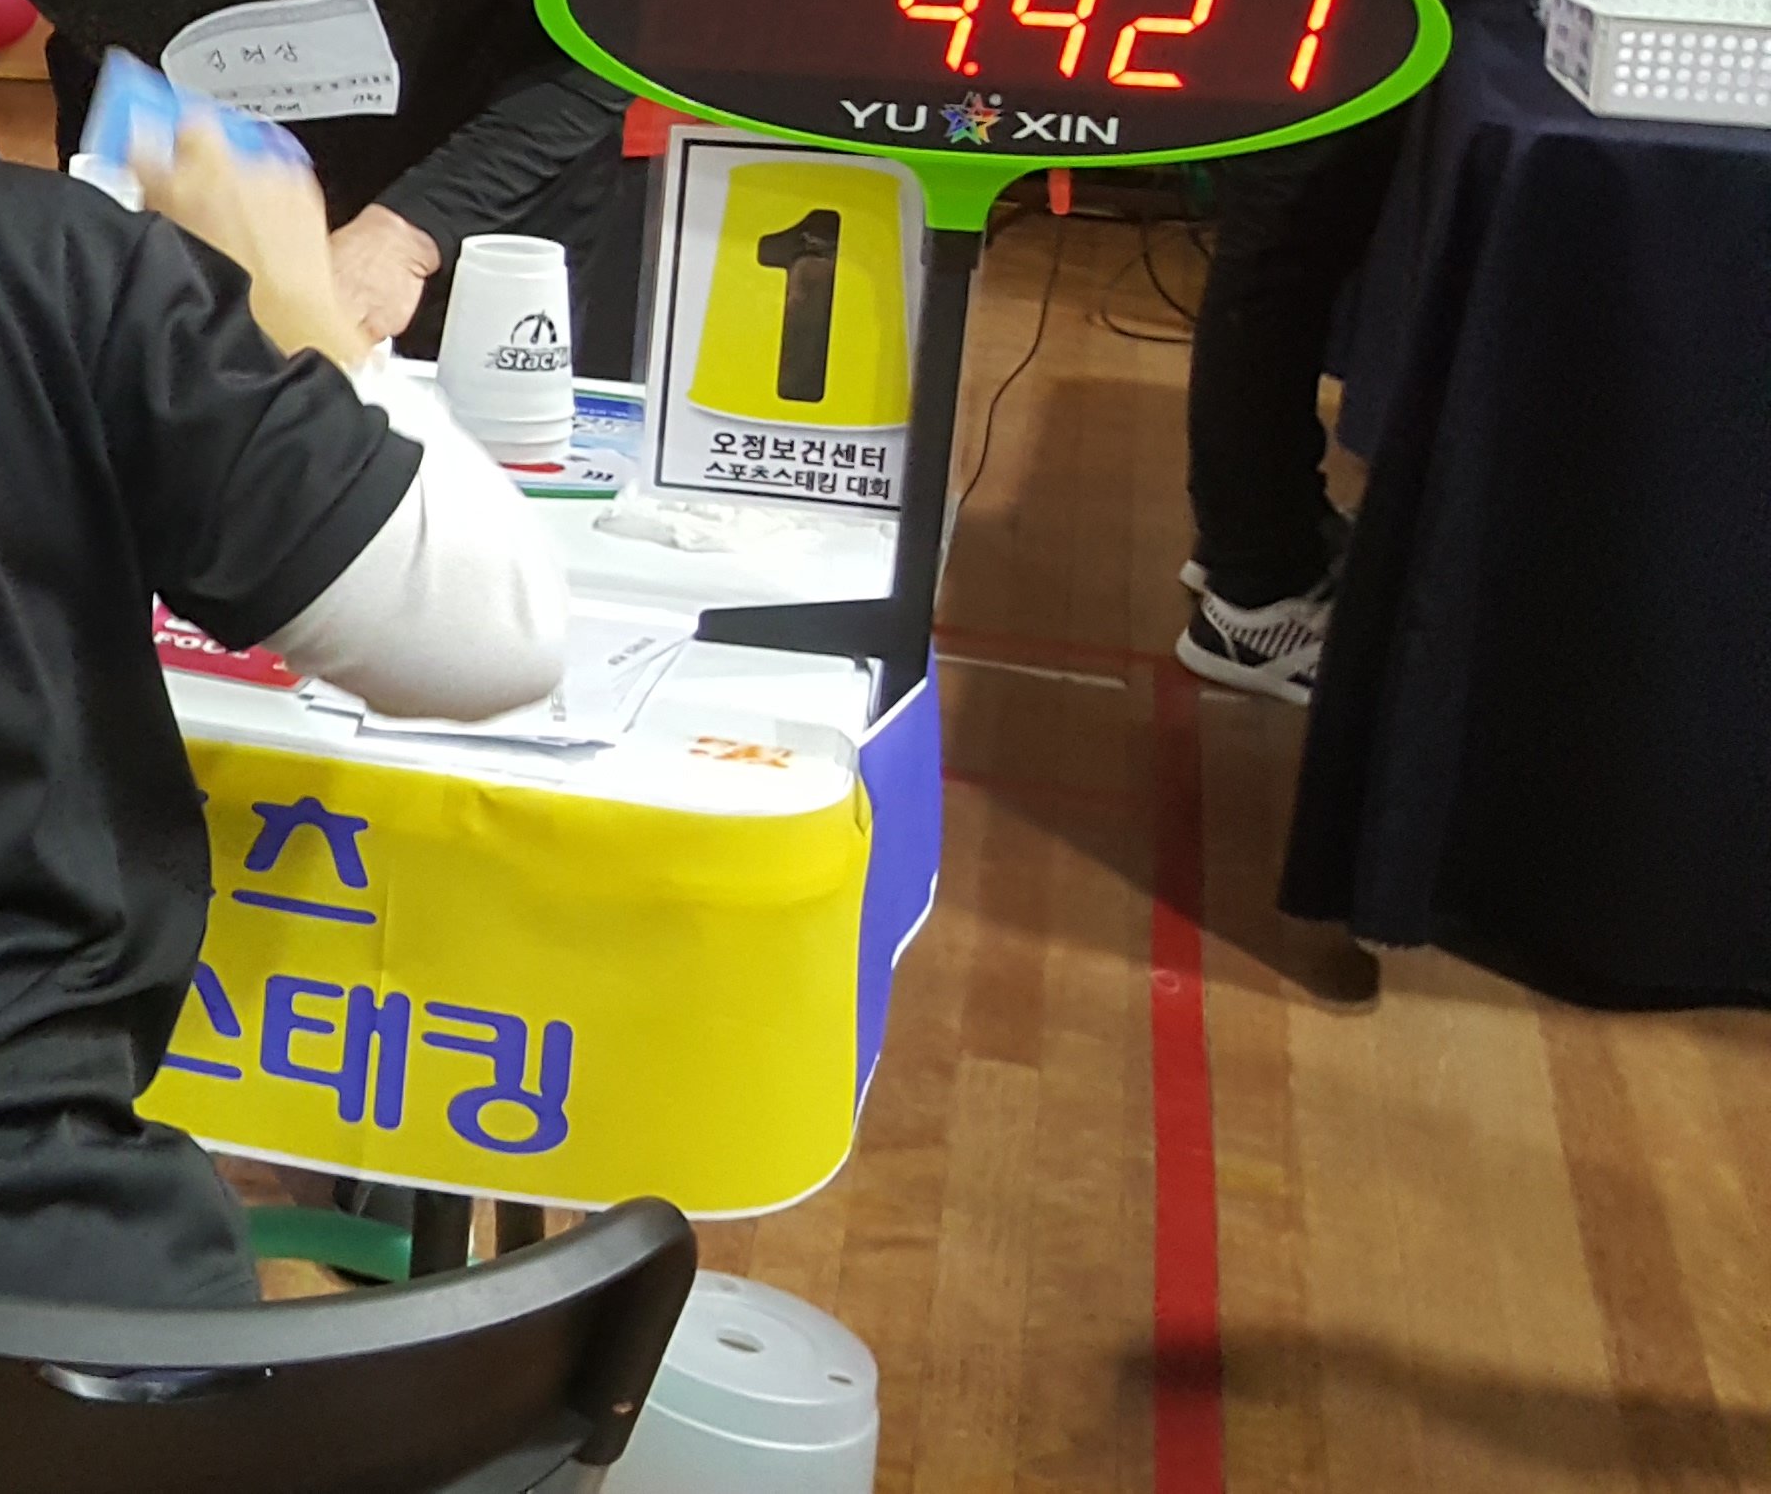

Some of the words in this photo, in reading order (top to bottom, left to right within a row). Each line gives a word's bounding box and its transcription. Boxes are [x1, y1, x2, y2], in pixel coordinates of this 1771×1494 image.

[839, 99, 929, 133] YU
[1011, 110, 1120, 145] XIN
[756, 208, 840, 403] 1
[710, 431, 887, 473] 오정보건센터
[846, 476, 891, 500] 대회
[200, 791, 378, 926] 츠
